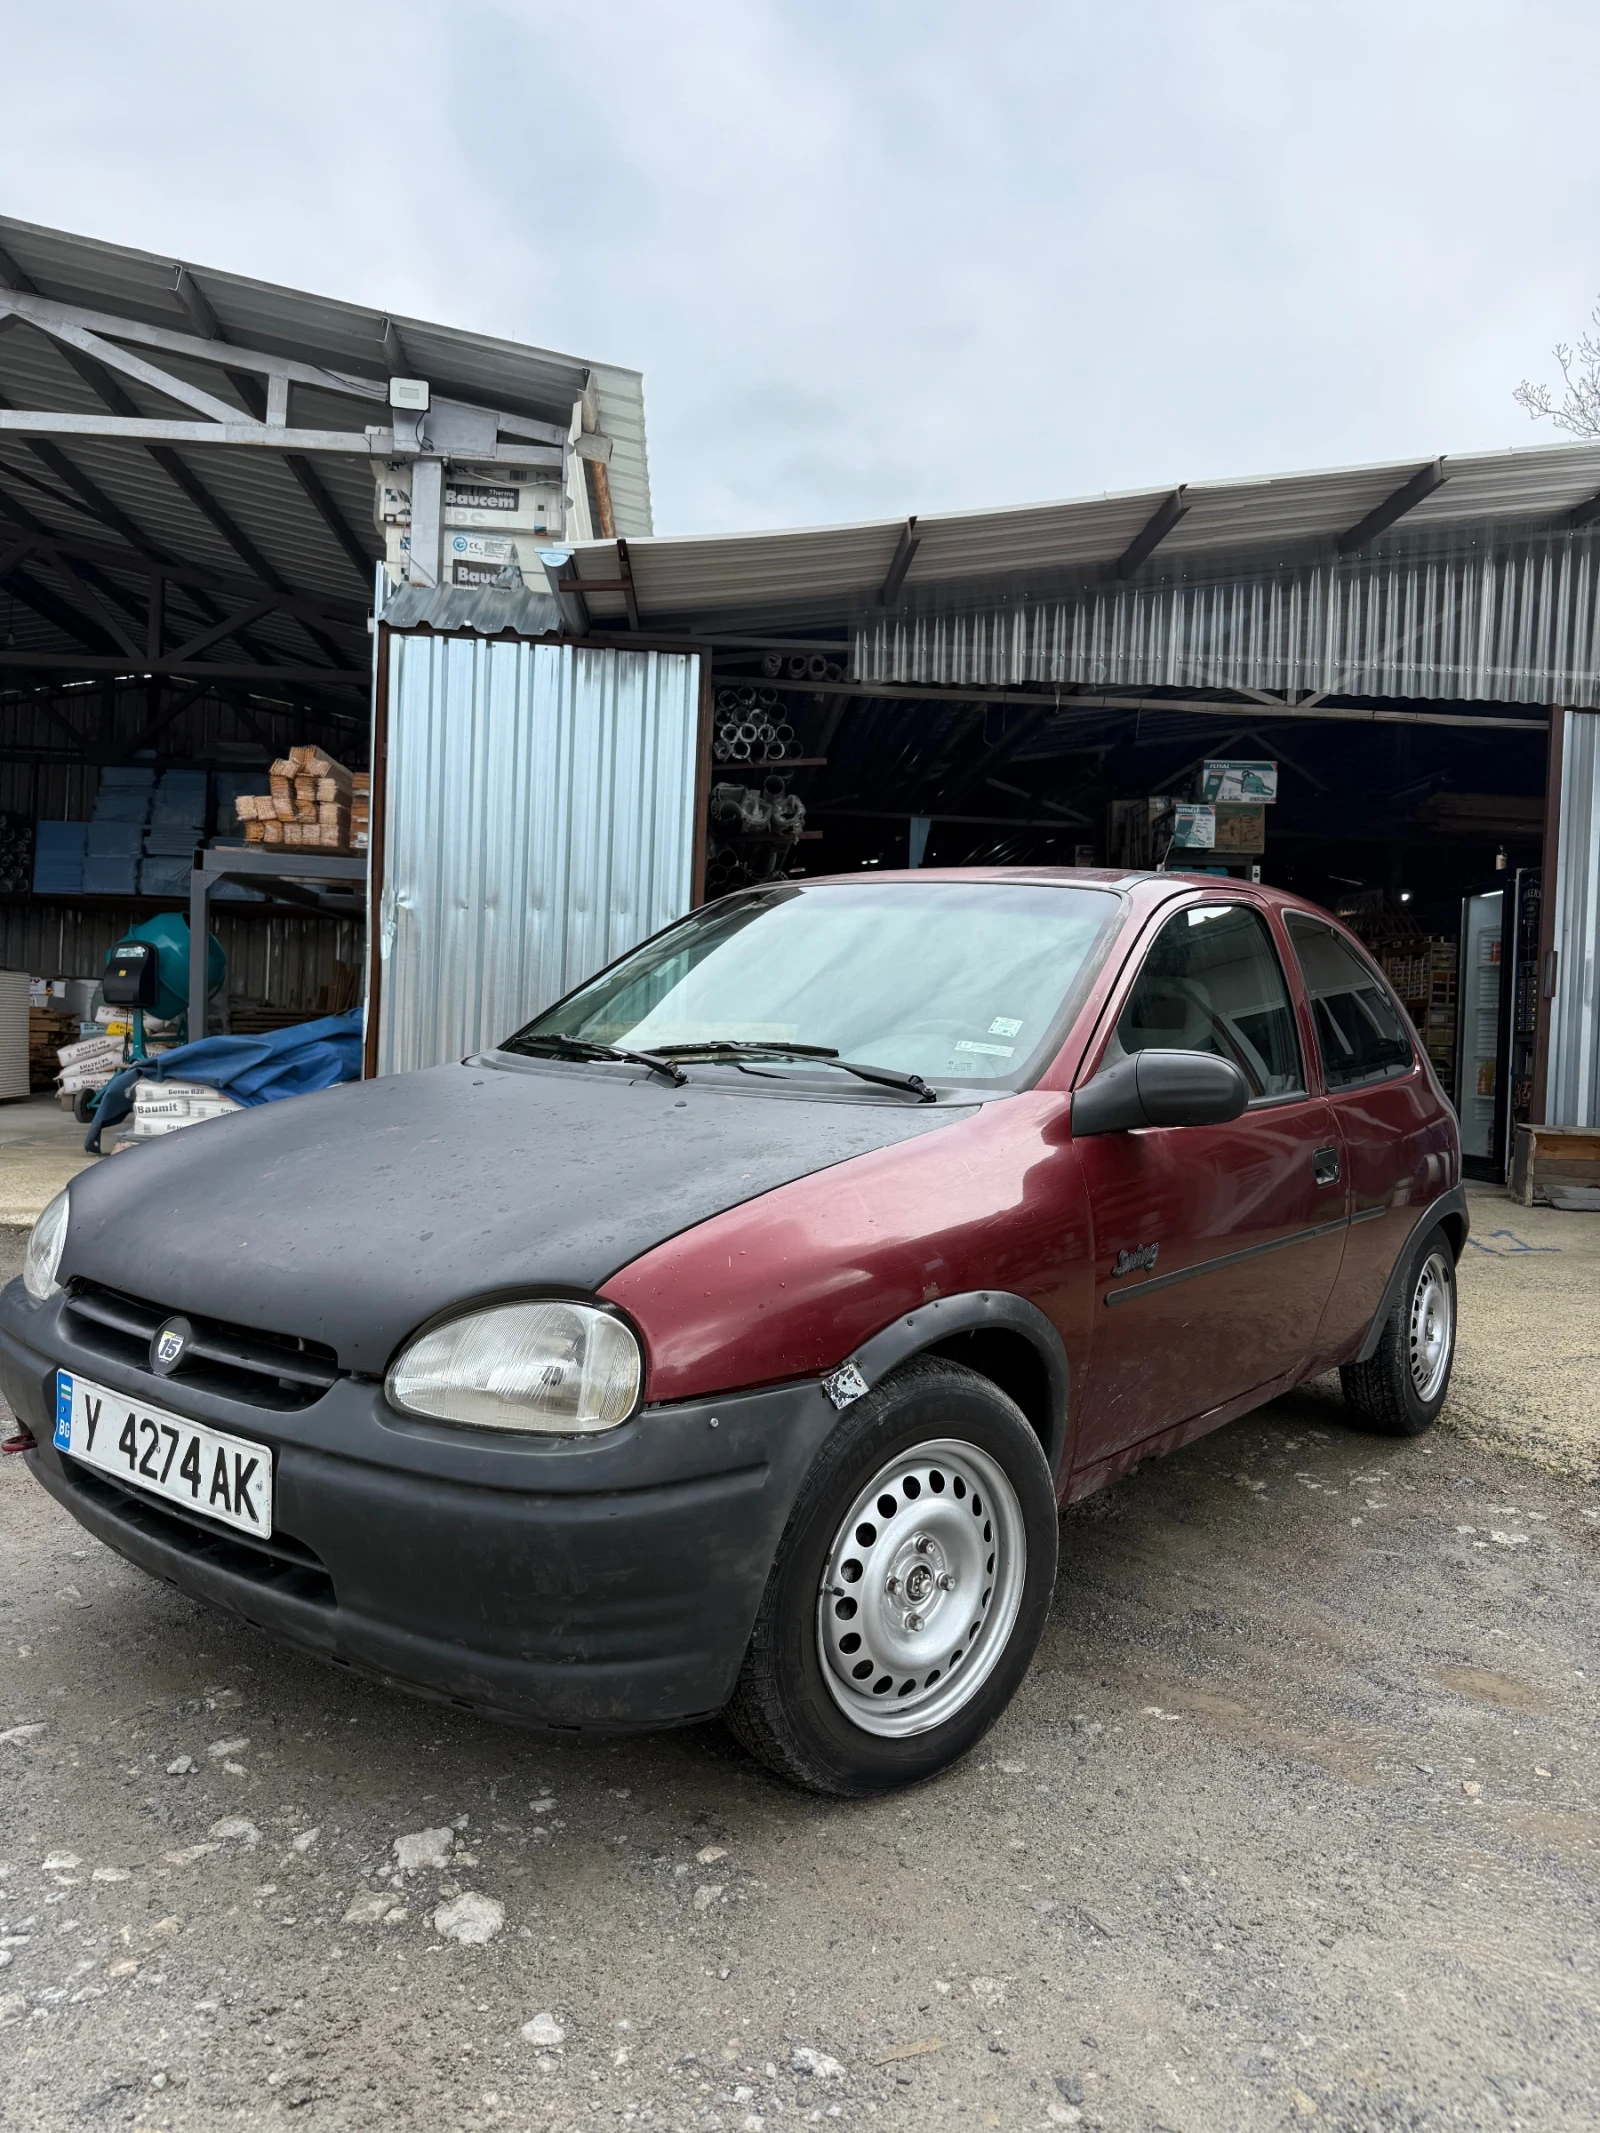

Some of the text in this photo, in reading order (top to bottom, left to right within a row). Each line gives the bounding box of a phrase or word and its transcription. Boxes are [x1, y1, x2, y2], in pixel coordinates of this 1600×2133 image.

[445, 490, 515, 508] Baucem
[489, 489, 515, 497] Thermo
[137, 1103, 178, 1114] Baumit
[159, 1338, 181, 1358] 15
[59, 1418, 70, 1438] BG
[85, 1393, 260, 1524] Y 4274 AK
